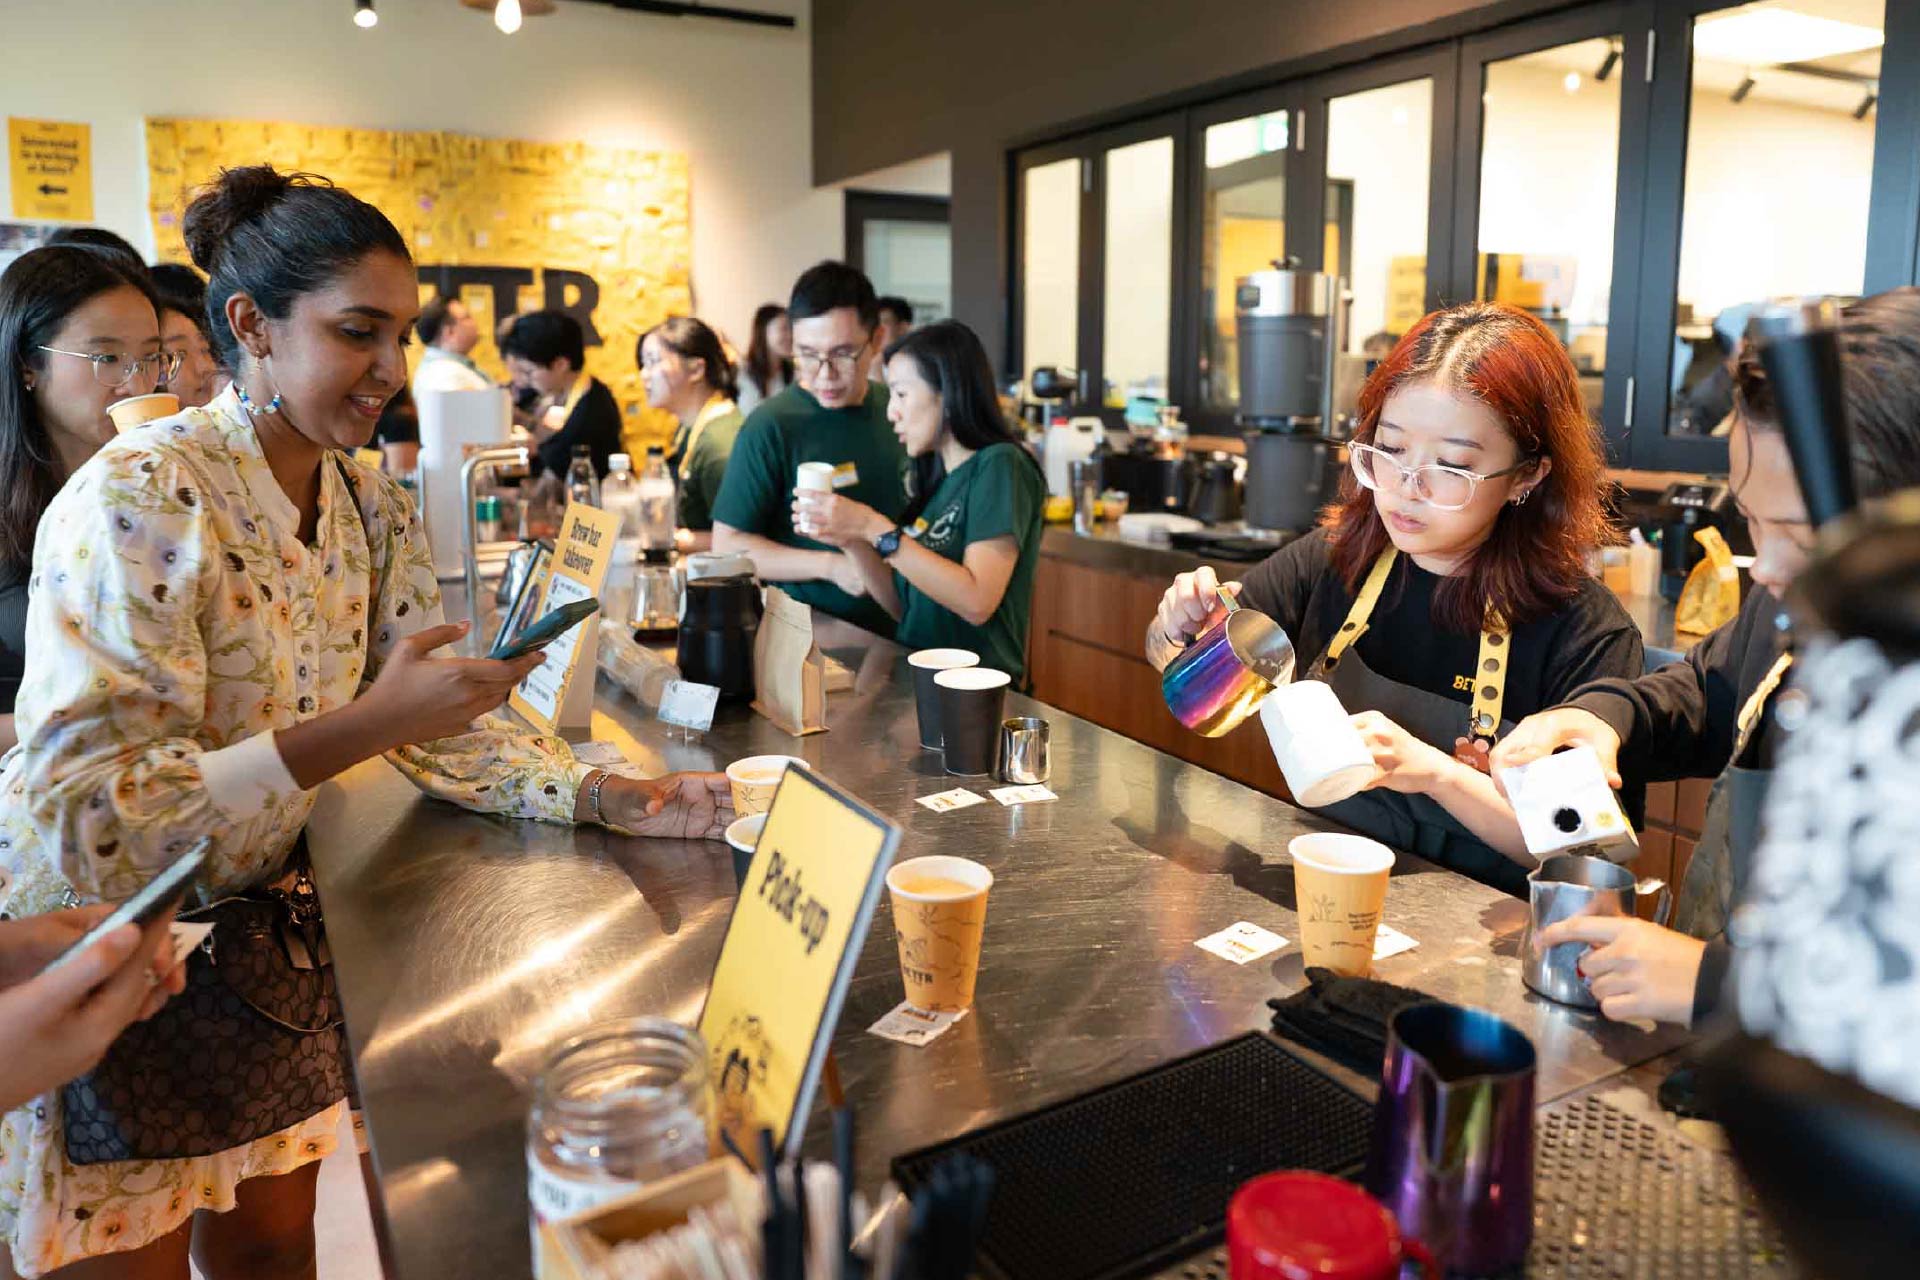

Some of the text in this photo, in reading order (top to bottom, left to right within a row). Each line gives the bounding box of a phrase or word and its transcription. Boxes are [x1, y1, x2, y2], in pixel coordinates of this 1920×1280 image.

[570, 516, 602, 548] Brew bar
[563, 546, 594, 576] takeover
[1453, 674, 1476, 693] BET
[758, 848, 829, 956] Pick-up
